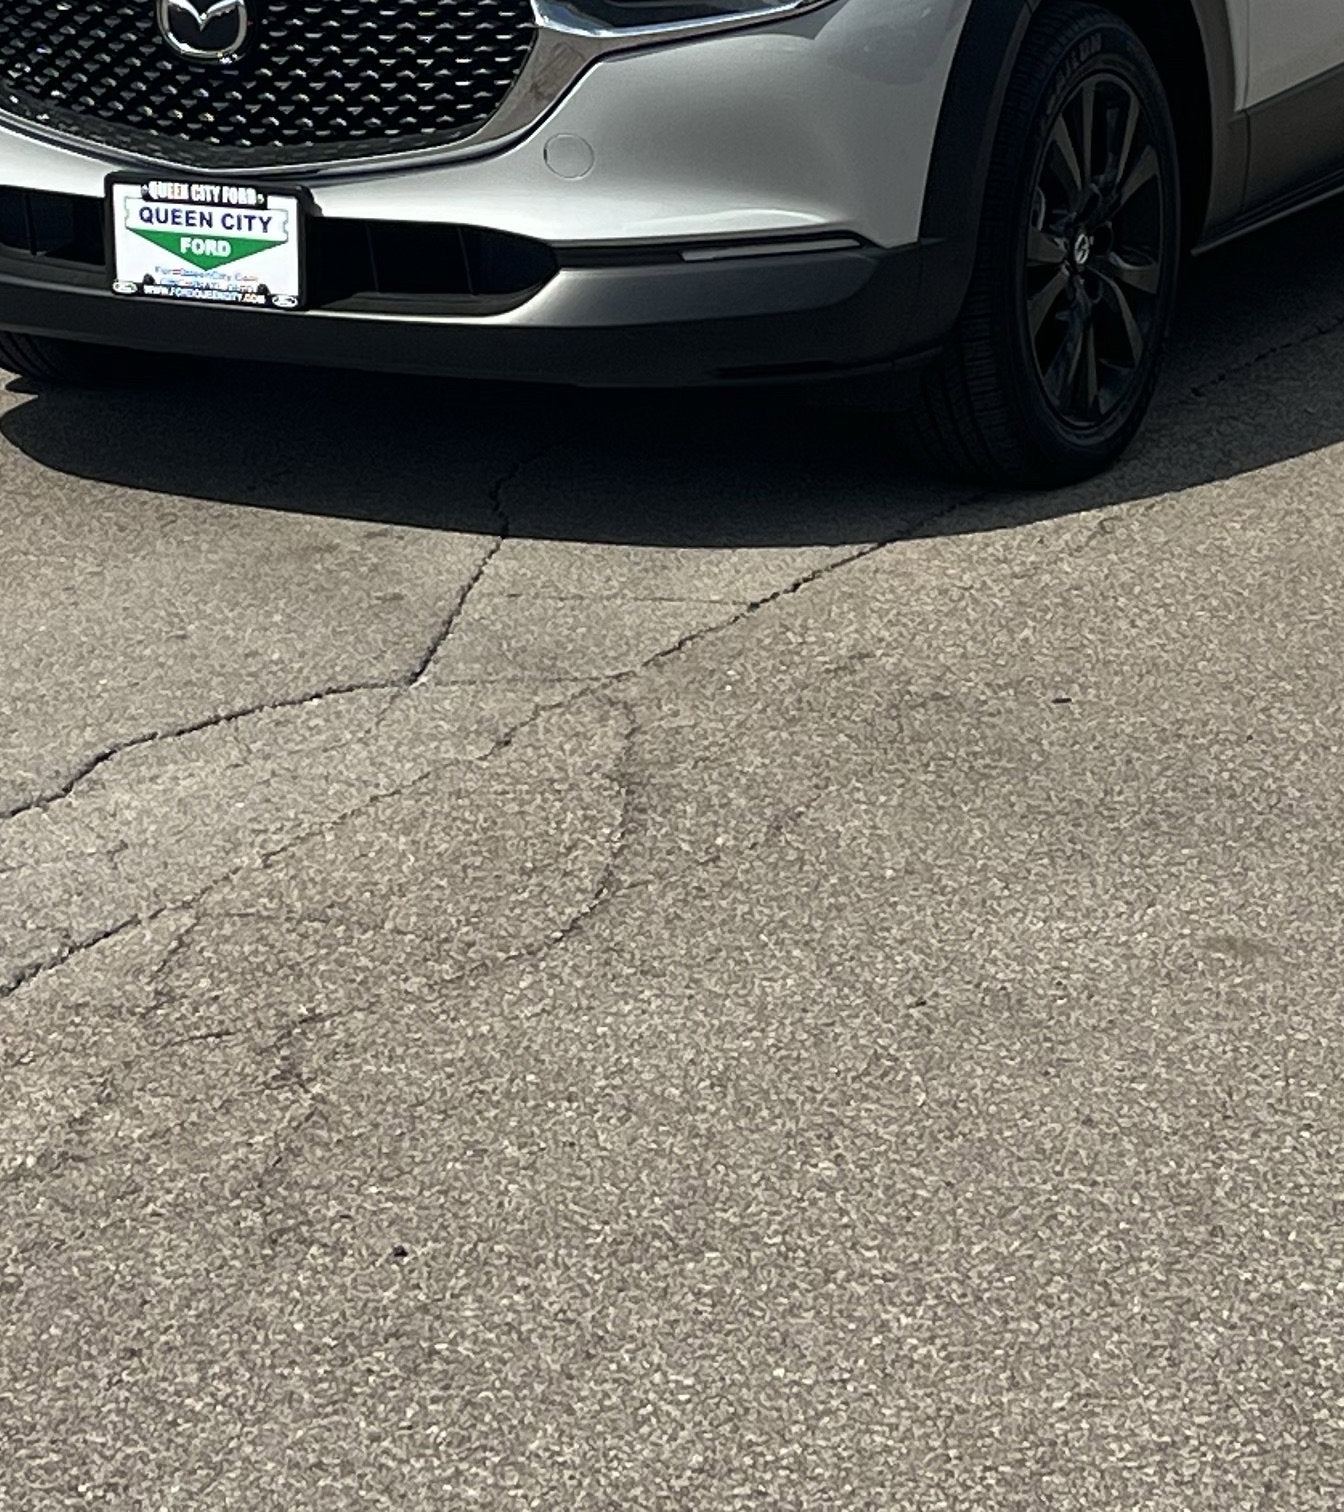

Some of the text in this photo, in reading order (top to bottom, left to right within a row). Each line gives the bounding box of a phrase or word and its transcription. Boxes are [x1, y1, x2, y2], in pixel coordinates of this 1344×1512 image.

[148, 181, 257, 206] QUEEN CITY FORD
[139, 206, 273, 233] QUEEN CITY
[180, 237, 232, 257] FORD
